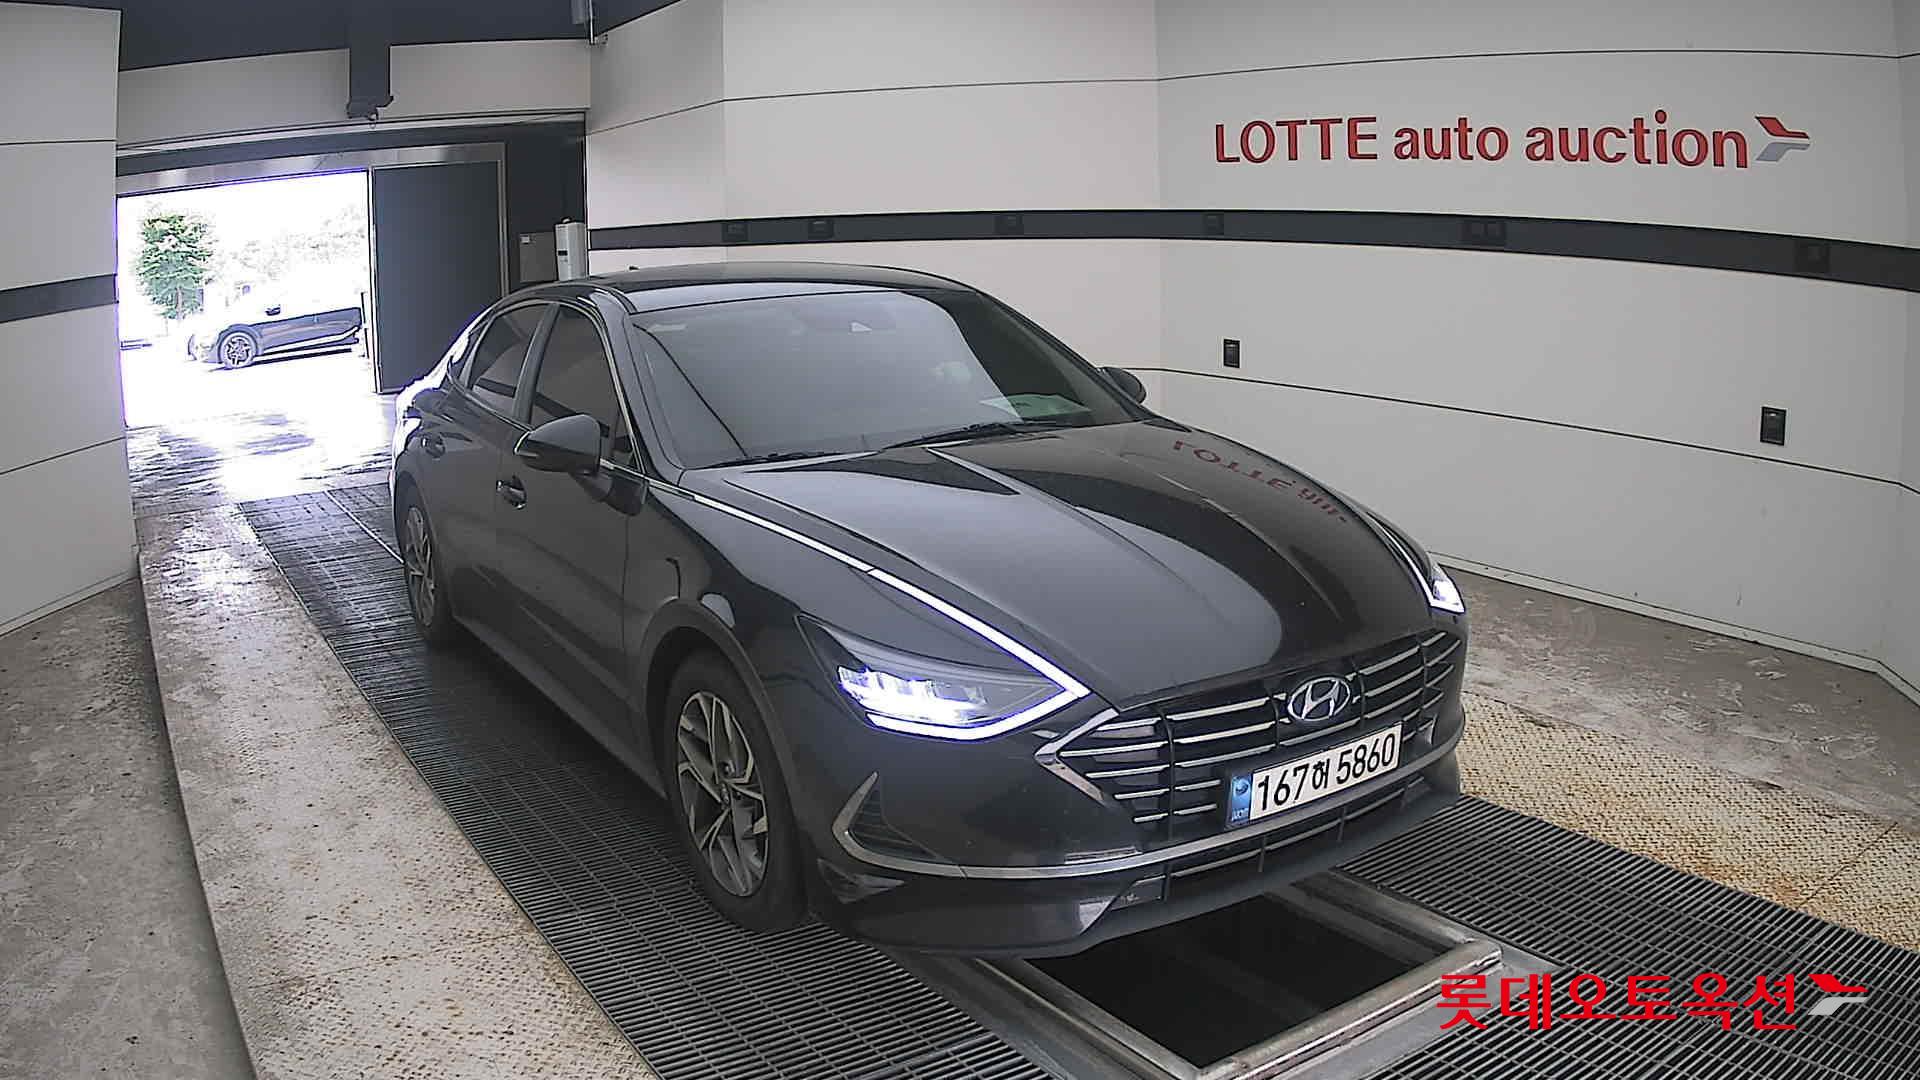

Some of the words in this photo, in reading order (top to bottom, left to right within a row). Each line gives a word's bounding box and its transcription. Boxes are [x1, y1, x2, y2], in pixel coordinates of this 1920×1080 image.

[1214, 116, 1378, 163] LOTTE
[1393, 117, 1510, 162] auto
[1525, 110, 1750, 169] auction
[1257, 758, 1330, 811] 167허
[1336, 733, 1396, 785] 5860
